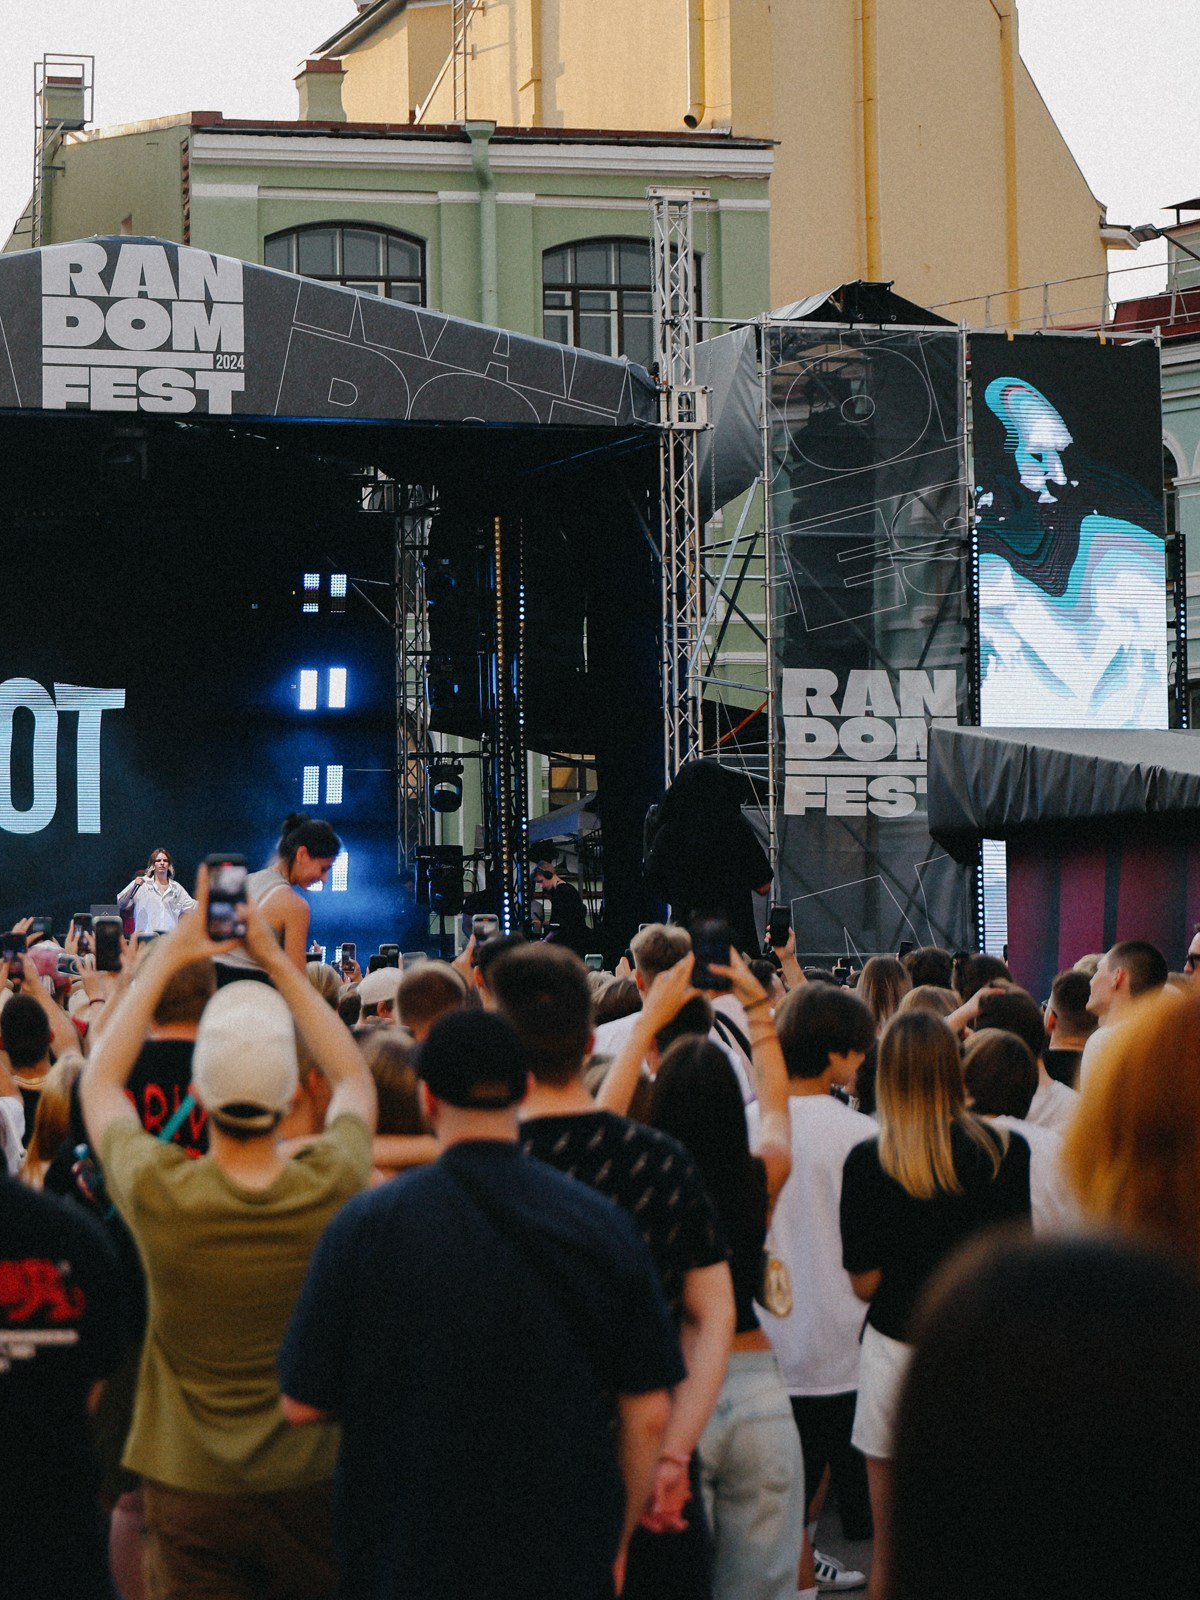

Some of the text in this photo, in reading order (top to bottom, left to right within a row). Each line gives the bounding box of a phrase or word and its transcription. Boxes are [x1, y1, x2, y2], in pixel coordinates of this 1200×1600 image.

[41, 242, 243, 303] RAN
[42, 296, 244, 353] DOM
[216, 354, 245, 370] 2024
[42, 366, 245, 415] FEST
[782, 668, 957, 717] RAN
[784, 776, 927, 817] FES
